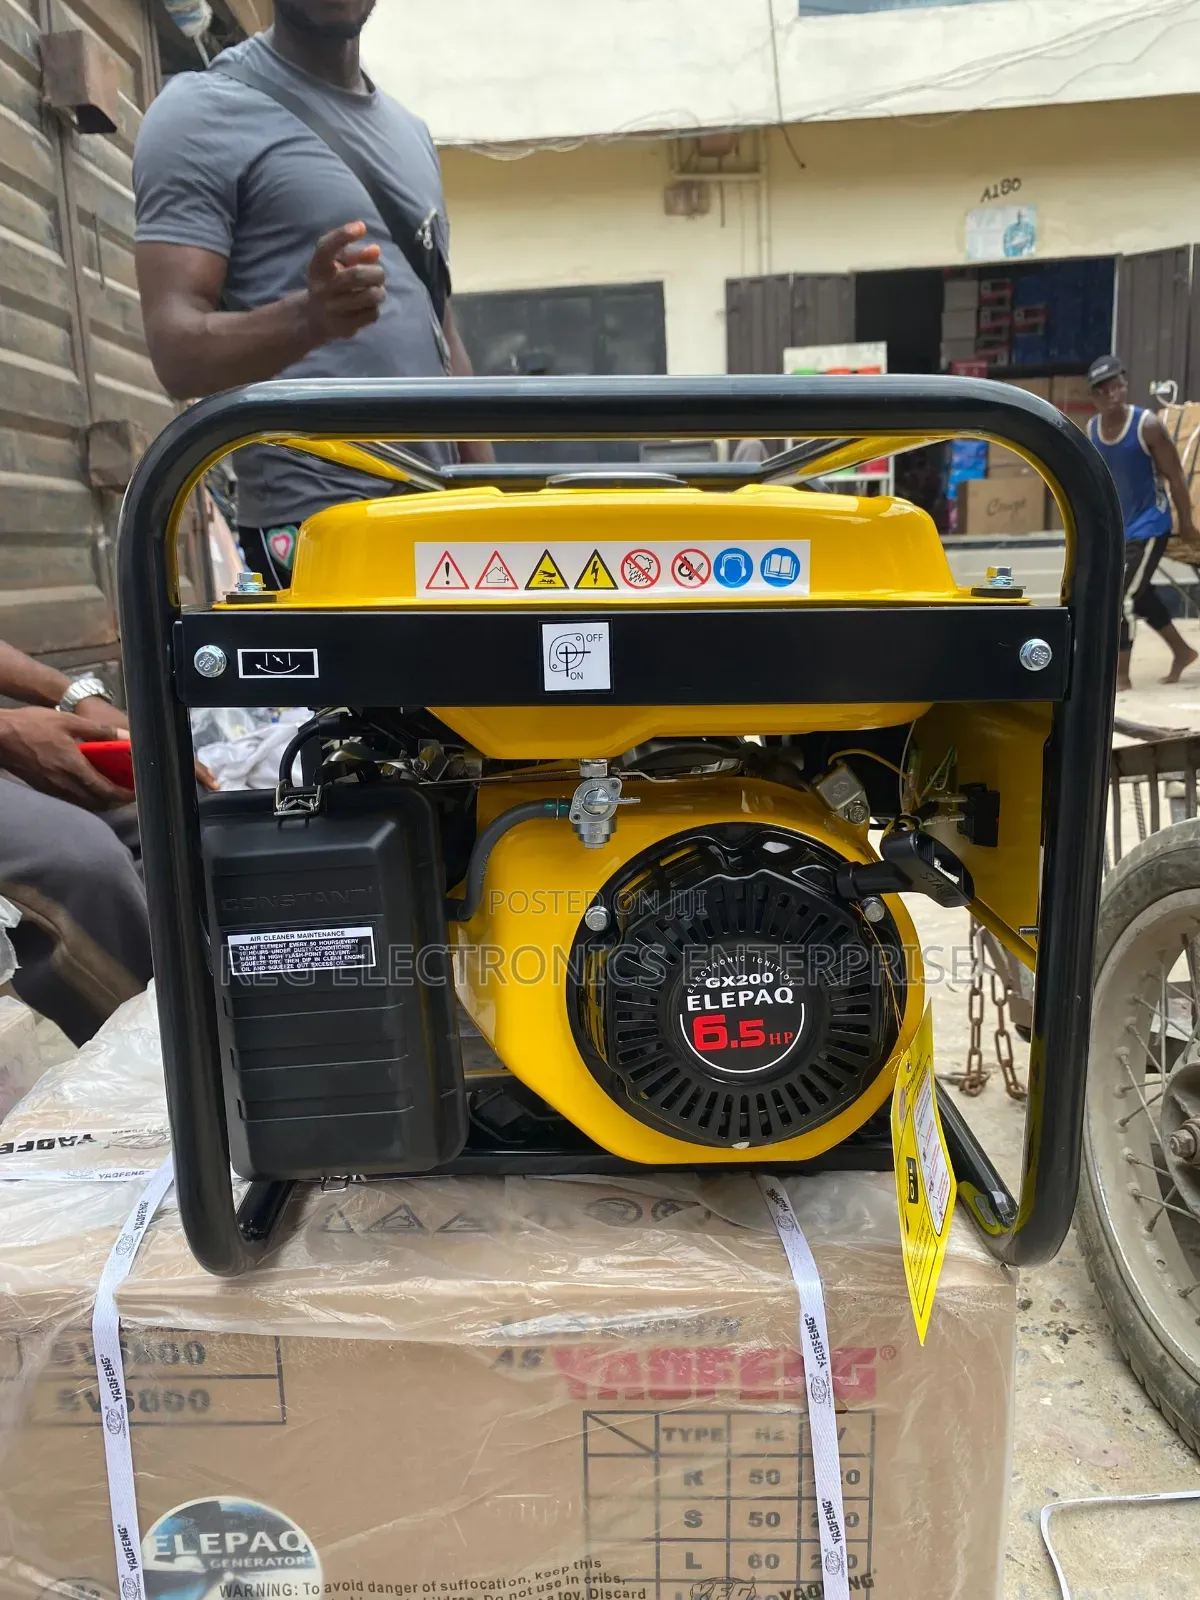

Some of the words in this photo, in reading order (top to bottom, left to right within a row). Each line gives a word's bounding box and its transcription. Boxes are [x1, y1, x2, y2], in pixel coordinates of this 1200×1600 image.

[980, 177, 1022, 203] A180
[586, 633, 603, 643] OFF
[570, 671, 584, 681] ON
[250, 935, 262, 943] AIR
[263, 933, 295, 942] CLEANER
[297, 930, 346, 939] MAINTENANCE
[687, 955, 746, 994] ELECTRONIC
[752, 956, 795, 987] IGNITION
[705, 972, 774, 989] GX200
[686, 987, 795, 1012] ELEPAQ
[693, 1014, 766, 1051] 6.5
[768, 1031, 794, 1046] HP
[804, 1316, 827, 1369] YAOFENG
[100, 1357, 123, 1403] YAOFENG
[661, 1427, 724, 1443] TYPE
[749, 1468, 781, 1486] 50
[683, 1509, 704, 1529] S
[748, 1511, 781, 1528] 50
[822, 1500, 843, 1546] YAOFENG
[117, 1527, 139, 1572] YAOFENG
[152, 1530, 309, 1556] ELEPAQ
[685, 1552, 702, 1570] L
[748, 1552, 780, 1570] 60
[219, 1582, 298, 1599] WARNING:
[303, 1581, 320, 1596] To
[324, 1579, 364, 1594] avoid
[367, 1581, 419, 1597] danger
[422, 1580, 437, 1593] of
[440, 1575, 531, 1592] suffocation,
[573, 1558, 602, 1570] this
[508, 1586, 533, 1600] not
[536, 1580, 562, 1593] use
[566, 1574, 580, 1586] in
[584, 1571, 627, 1586] cribs,
[589, 1587, 647, 1600] Discard
